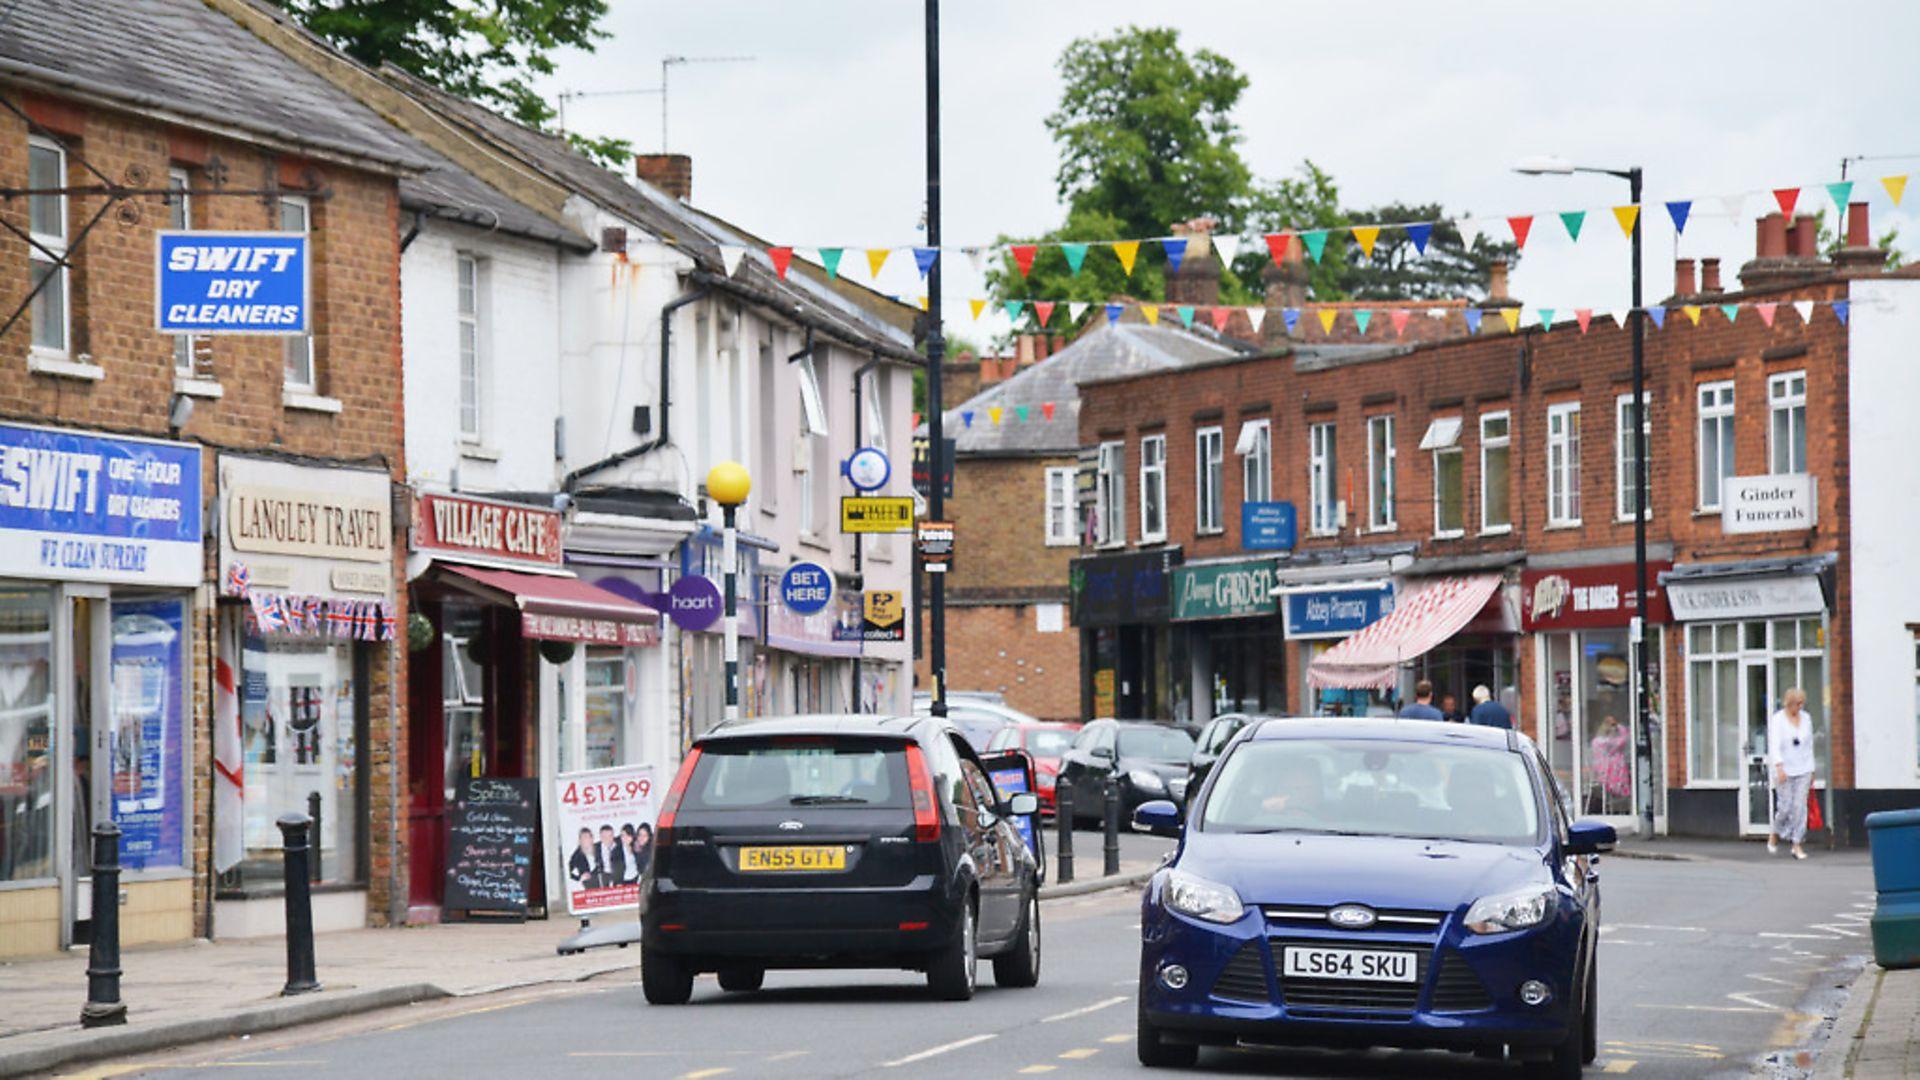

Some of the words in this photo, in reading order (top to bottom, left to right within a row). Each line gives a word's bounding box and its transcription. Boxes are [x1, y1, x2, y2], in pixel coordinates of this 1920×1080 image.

[168, 246, 297, 272] SWIFT
[207, 279, 261, 298] DRY
[168, 304, 298, 324] CLEANERS
[2, 446, 102, 514] SWIFT
[109, 458, 181, 484] ONE-HOUR
[1740, 487, 1796, 501] Ginder
[239, 497, 318, 543] LANGLEY
[324, 505, 385, 549] TRAVEL
[1735, 505, 1804, 522] Funerals
[432, 499, 502, 549] VILLAGE
[505, 510, 547, 555] CAFE
[791, 571, 821, 586] BET
[672, 595, 714, 610] haart
[786, 588, 826, 601] HERE
[1306, 597, 1330, 626] Abbey
[1330, 595, 1367, 624] Pharmacy
[749, 849, 796, 866] EN55
[801, 849, 836, 866] GTY
[1294, 952, 1354, 974] LS64
[1361, 955, 1407, 977] SKU
